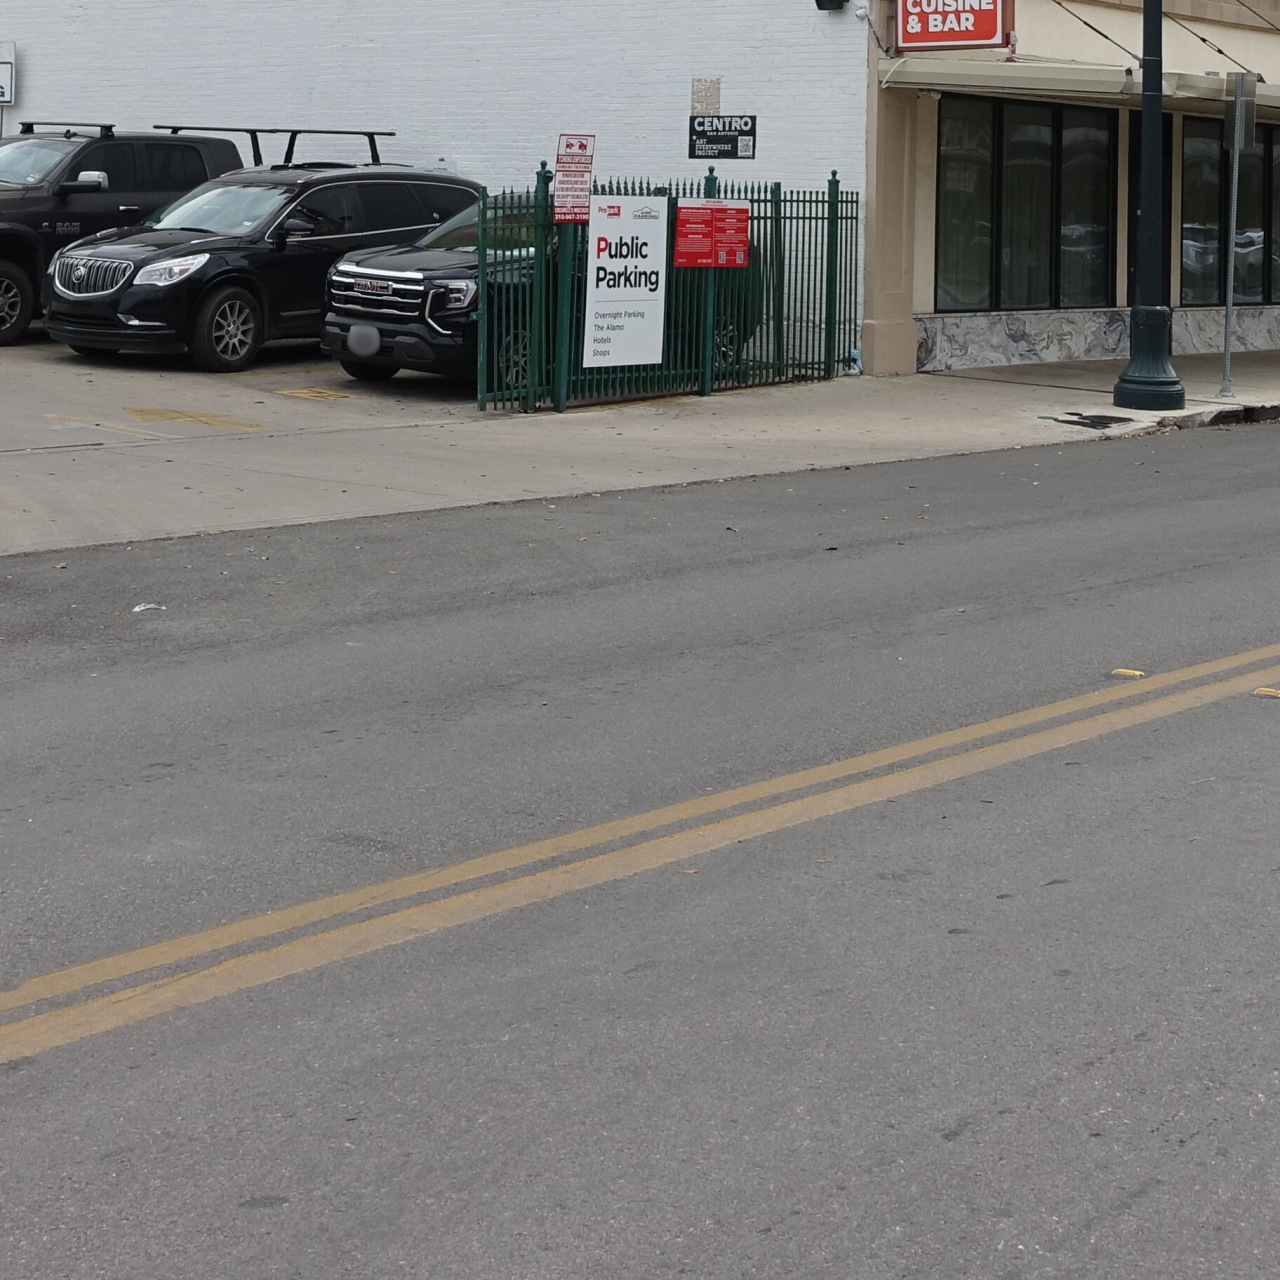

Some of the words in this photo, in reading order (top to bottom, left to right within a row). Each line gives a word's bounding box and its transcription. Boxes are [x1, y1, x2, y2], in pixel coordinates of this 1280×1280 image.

[906, 15, 921, 33] &
[928, 13, 975, 32] BAR
[694, 117, 752, 131] CENTRO
[596, 236, 649, 259] Public
[595, 265, 659, 293] Parking
[594, 310, 623, 321] Overnight
[624, 309, 645, 320] Parking
[594, 323, 605, 332] The
[606, 323, 624, 332] Alamo
[593, 336, 611, 345] Hotels
[592, 348, 610, 359] Shops
